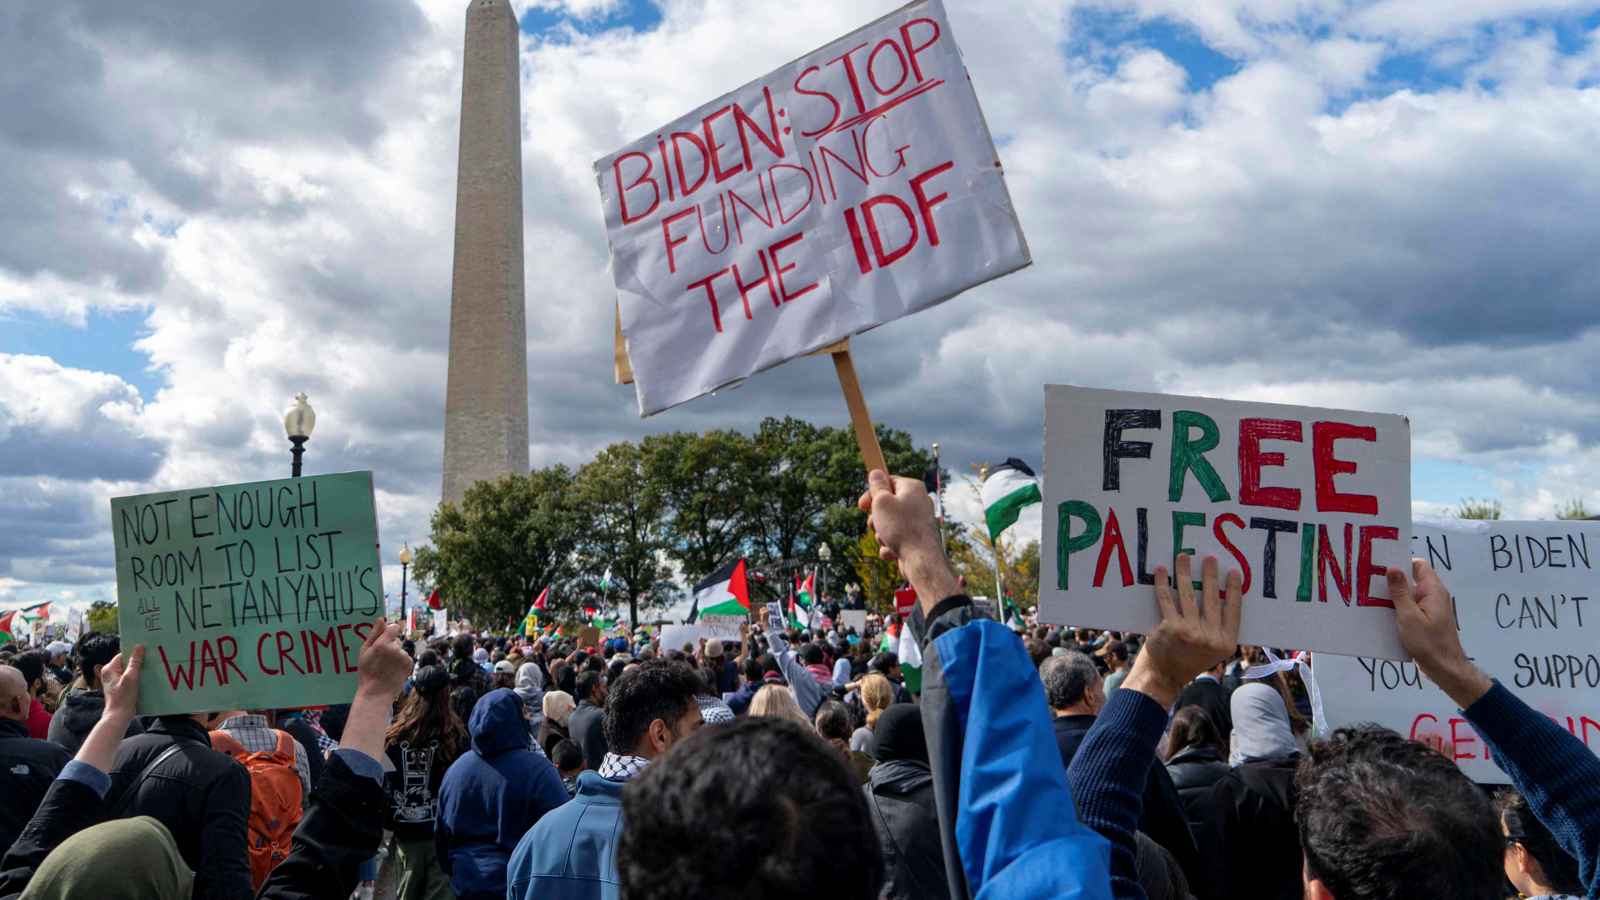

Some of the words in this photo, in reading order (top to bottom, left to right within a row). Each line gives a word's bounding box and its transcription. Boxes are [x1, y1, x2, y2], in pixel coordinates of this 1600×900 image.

[795, 18, 942, 138] STOP
[662, 116, 909, 273] FUNDING
[688, 233, 818, 332] THE
[844, 162, 953, 273] IDF
[1103, 409, 1379, 515] FREE
[121, 499, 178, 548] NOT
[190, 481, 319, 538] ENOUGH
[131, 546, 203, 592] ROOM
[215, 539, 256, 584] TO
[275, 531, 342, 574] LIST
[1057, 500, 1399, 607] PALESTINE
[1490, 533, 1591, 573] BIDEN
[175, 566, 379, 633] NETANYAHU'S
[1496, 593, 1588, 629] CAN'T
[159, 636, 247, 691] WAR
[1357, 656, 1423, 692] YOU
[1514, 653, 1600, 688] SUPPO
